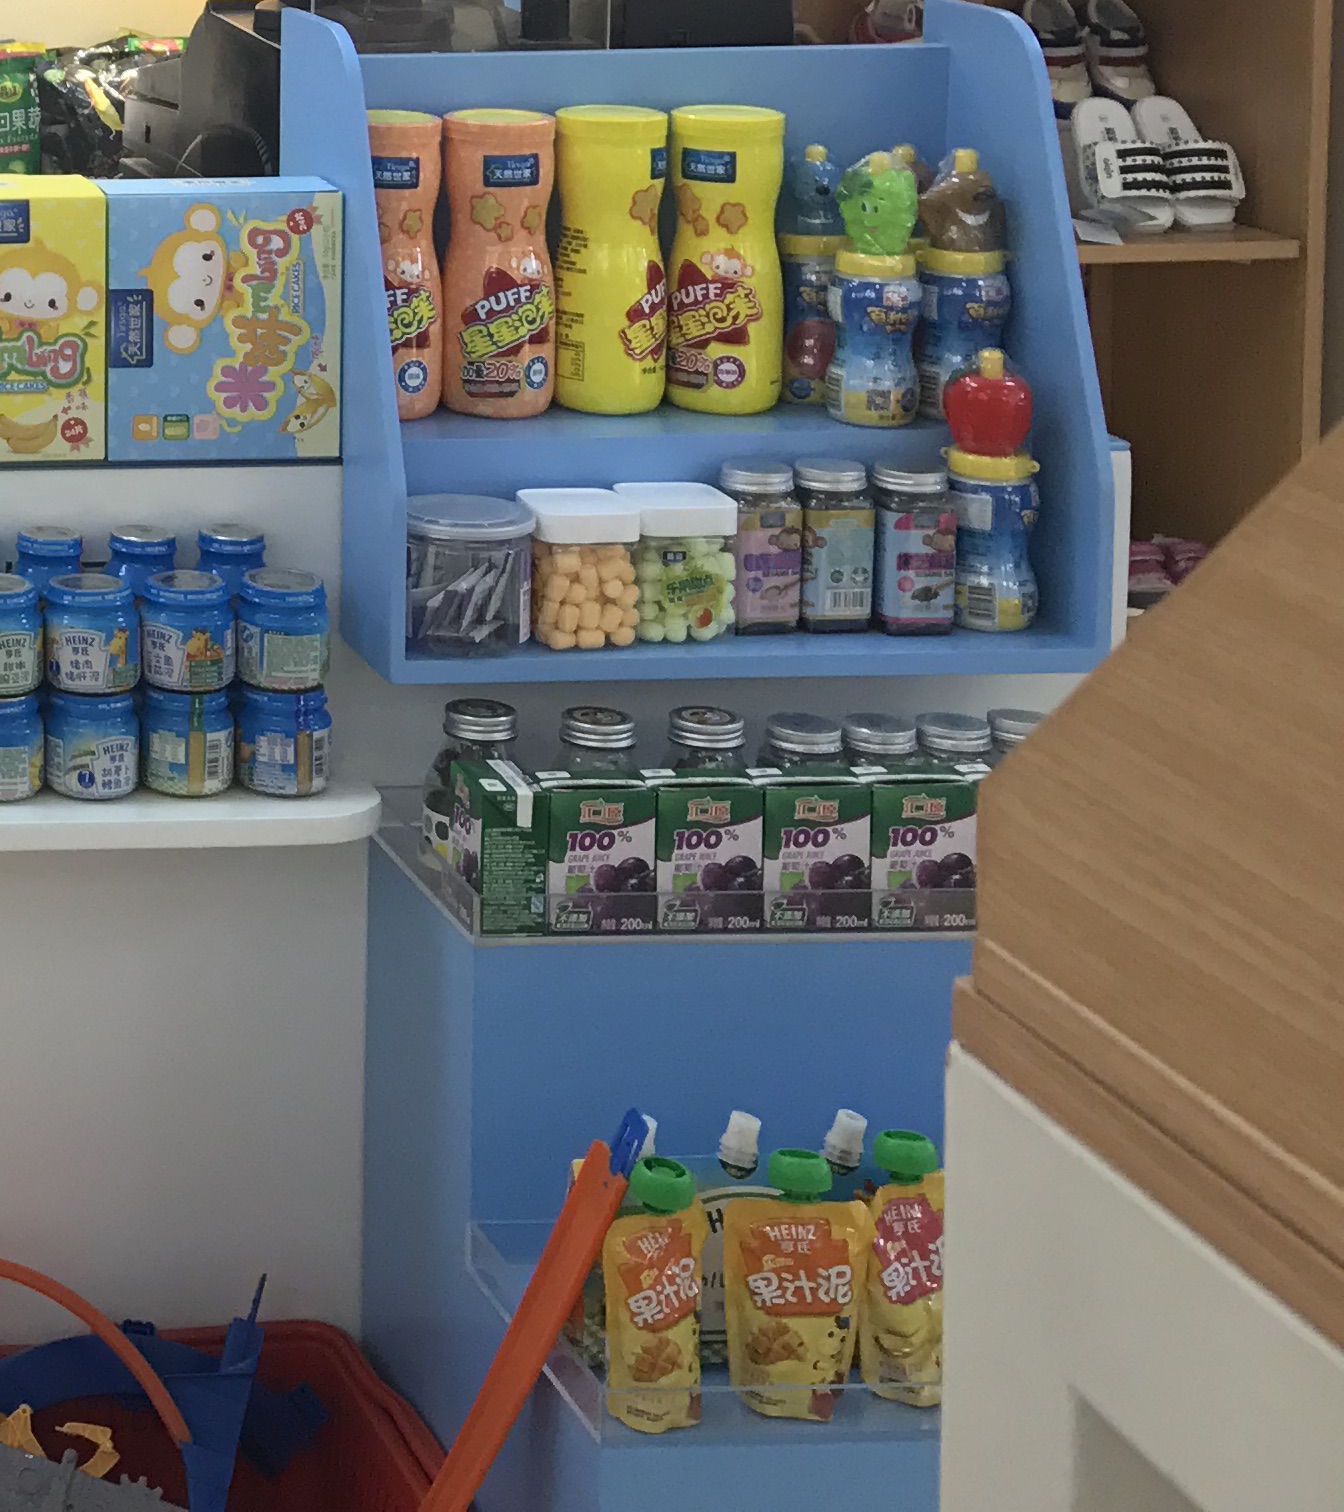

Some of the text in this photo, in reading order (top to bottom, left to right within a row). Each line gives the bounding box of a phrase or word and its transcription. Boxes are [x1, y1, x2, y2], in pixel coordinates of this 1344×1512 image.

[475, 285, 532, 320] PUFF
[672, 283, 722, 311] PUFF
[765, 1224, 817, 1241] HEINZ
[747, 1264, 853, 1307] 果汁泥
